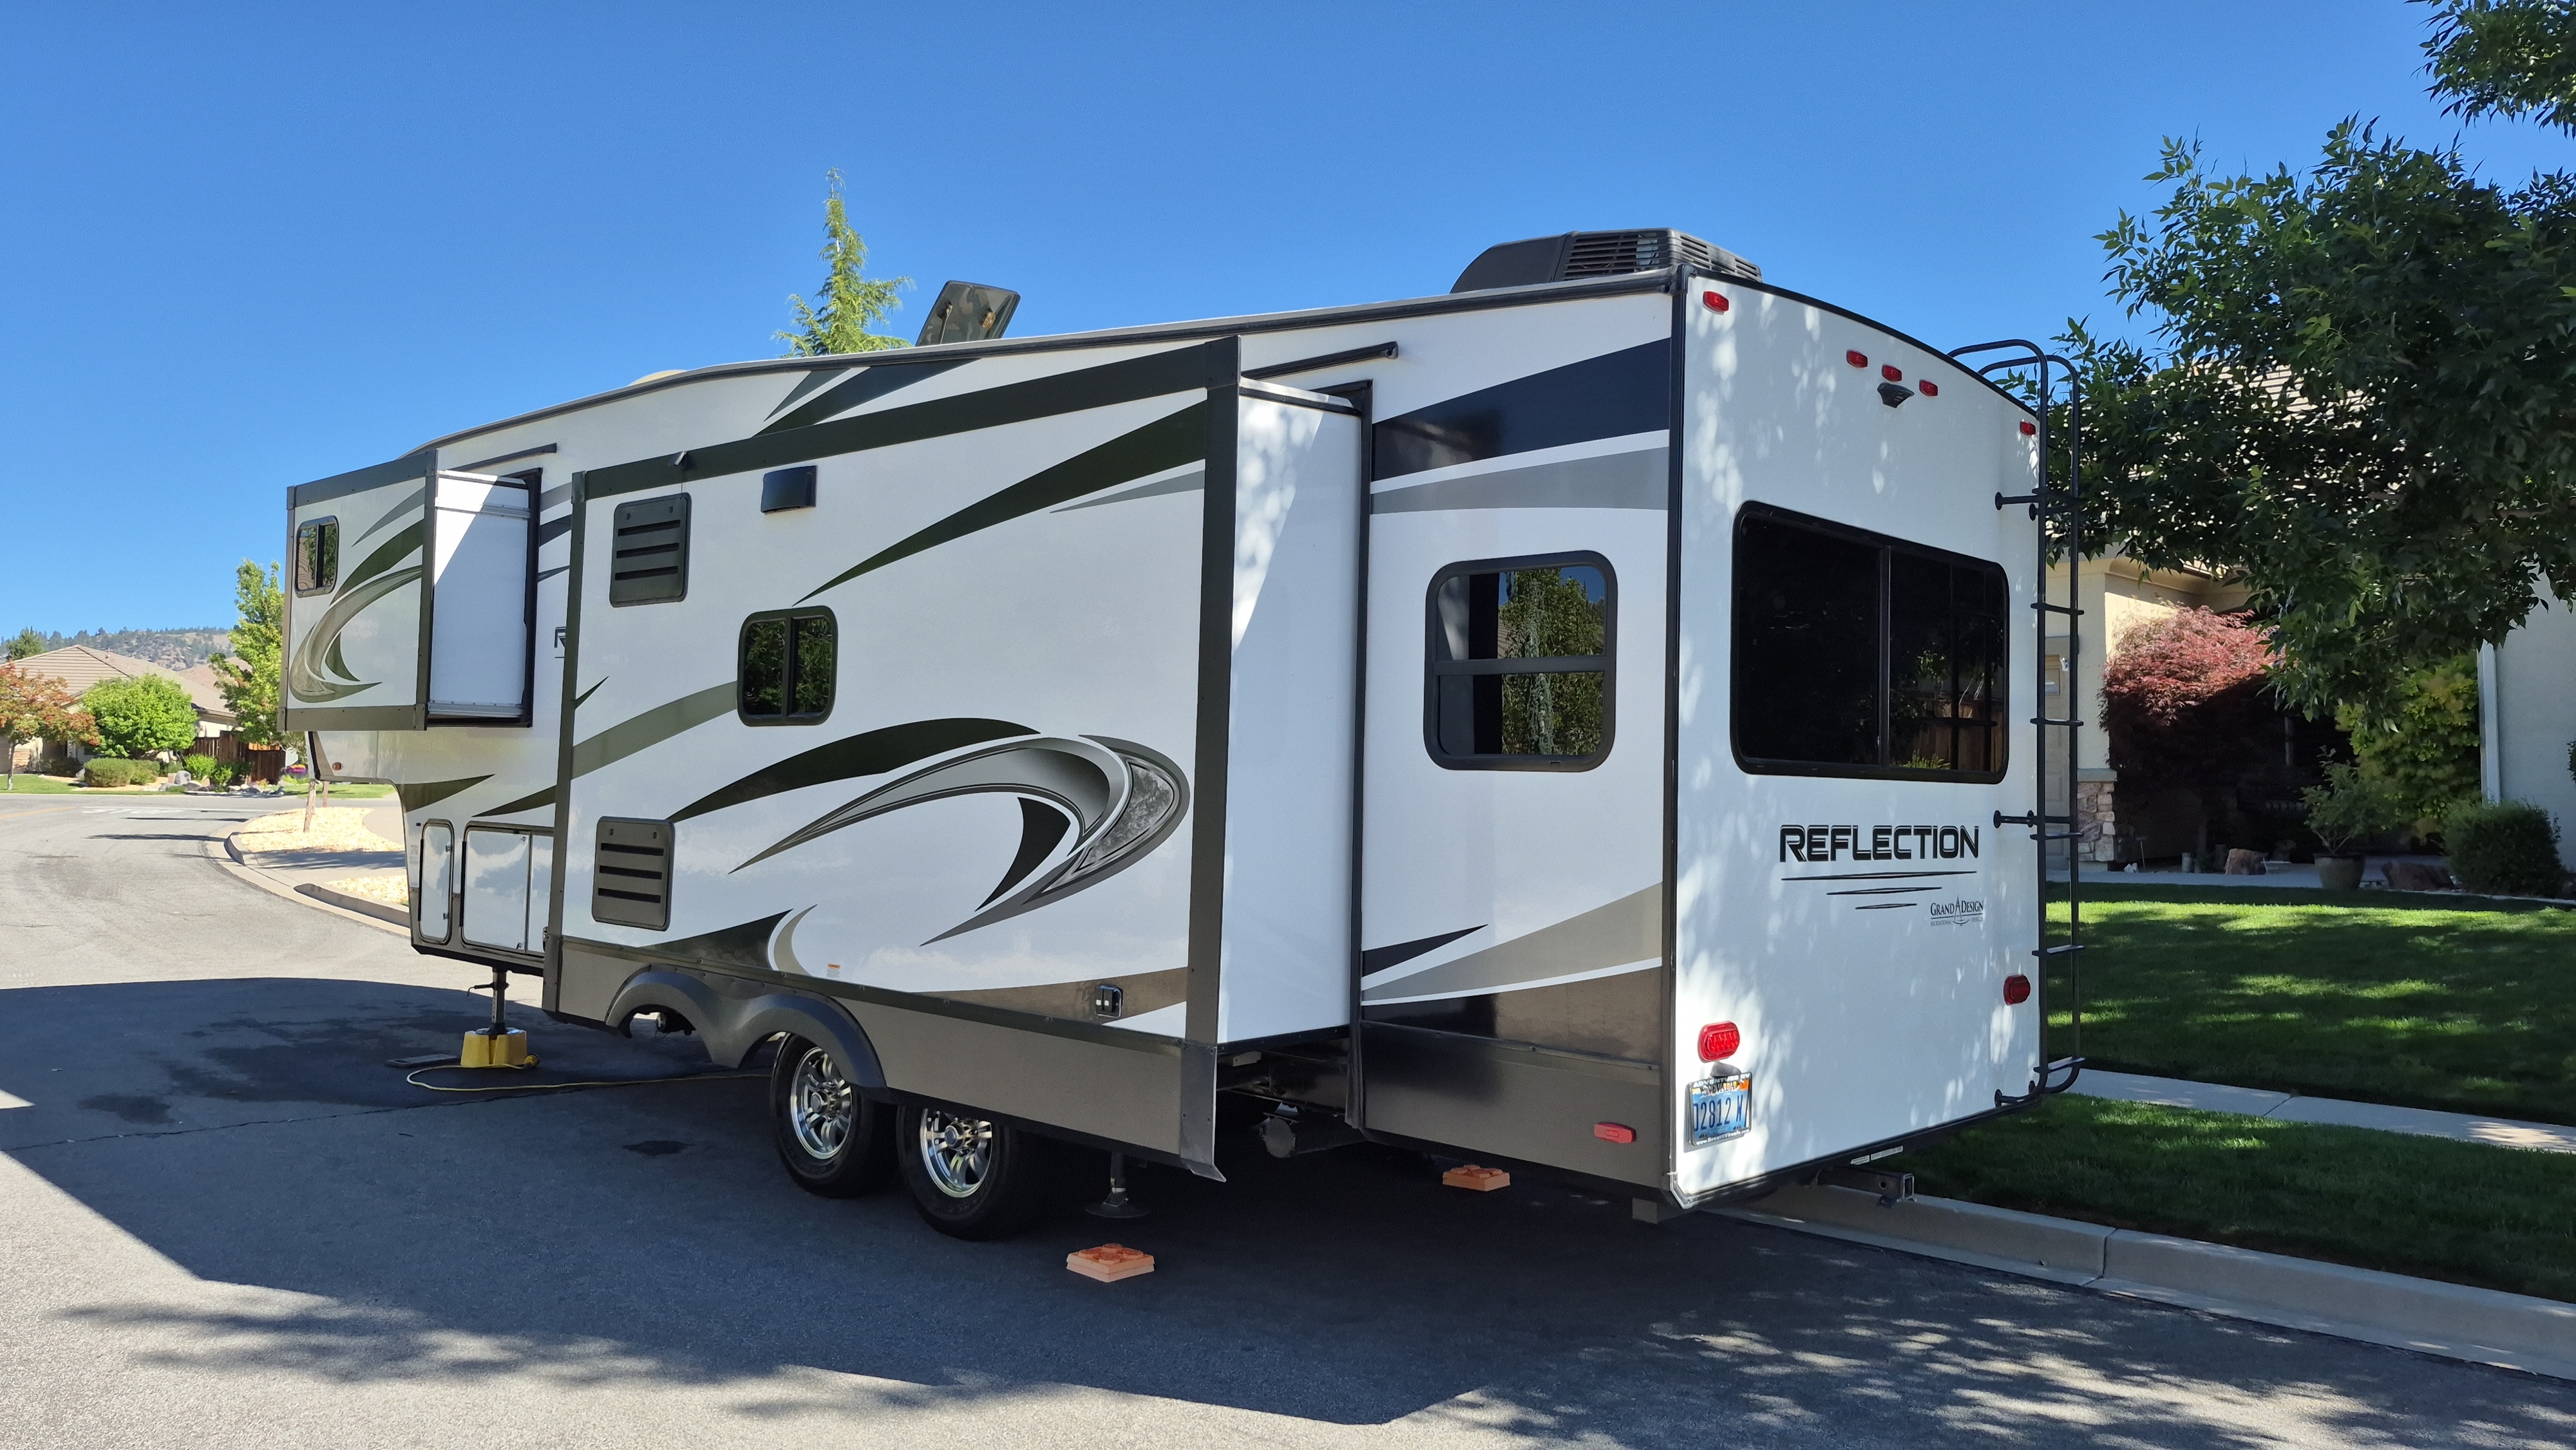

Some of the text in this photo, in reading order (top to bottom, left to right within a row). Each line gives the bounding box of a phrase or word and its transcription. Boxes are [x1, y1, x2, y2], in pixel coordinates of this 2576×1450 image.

[1779, 824, 1979, 862] REFLECTION
[1930, 900, 1984, 916] GRAND DESIGN
[1708, 1081, 1735, 1093] NEVADA
